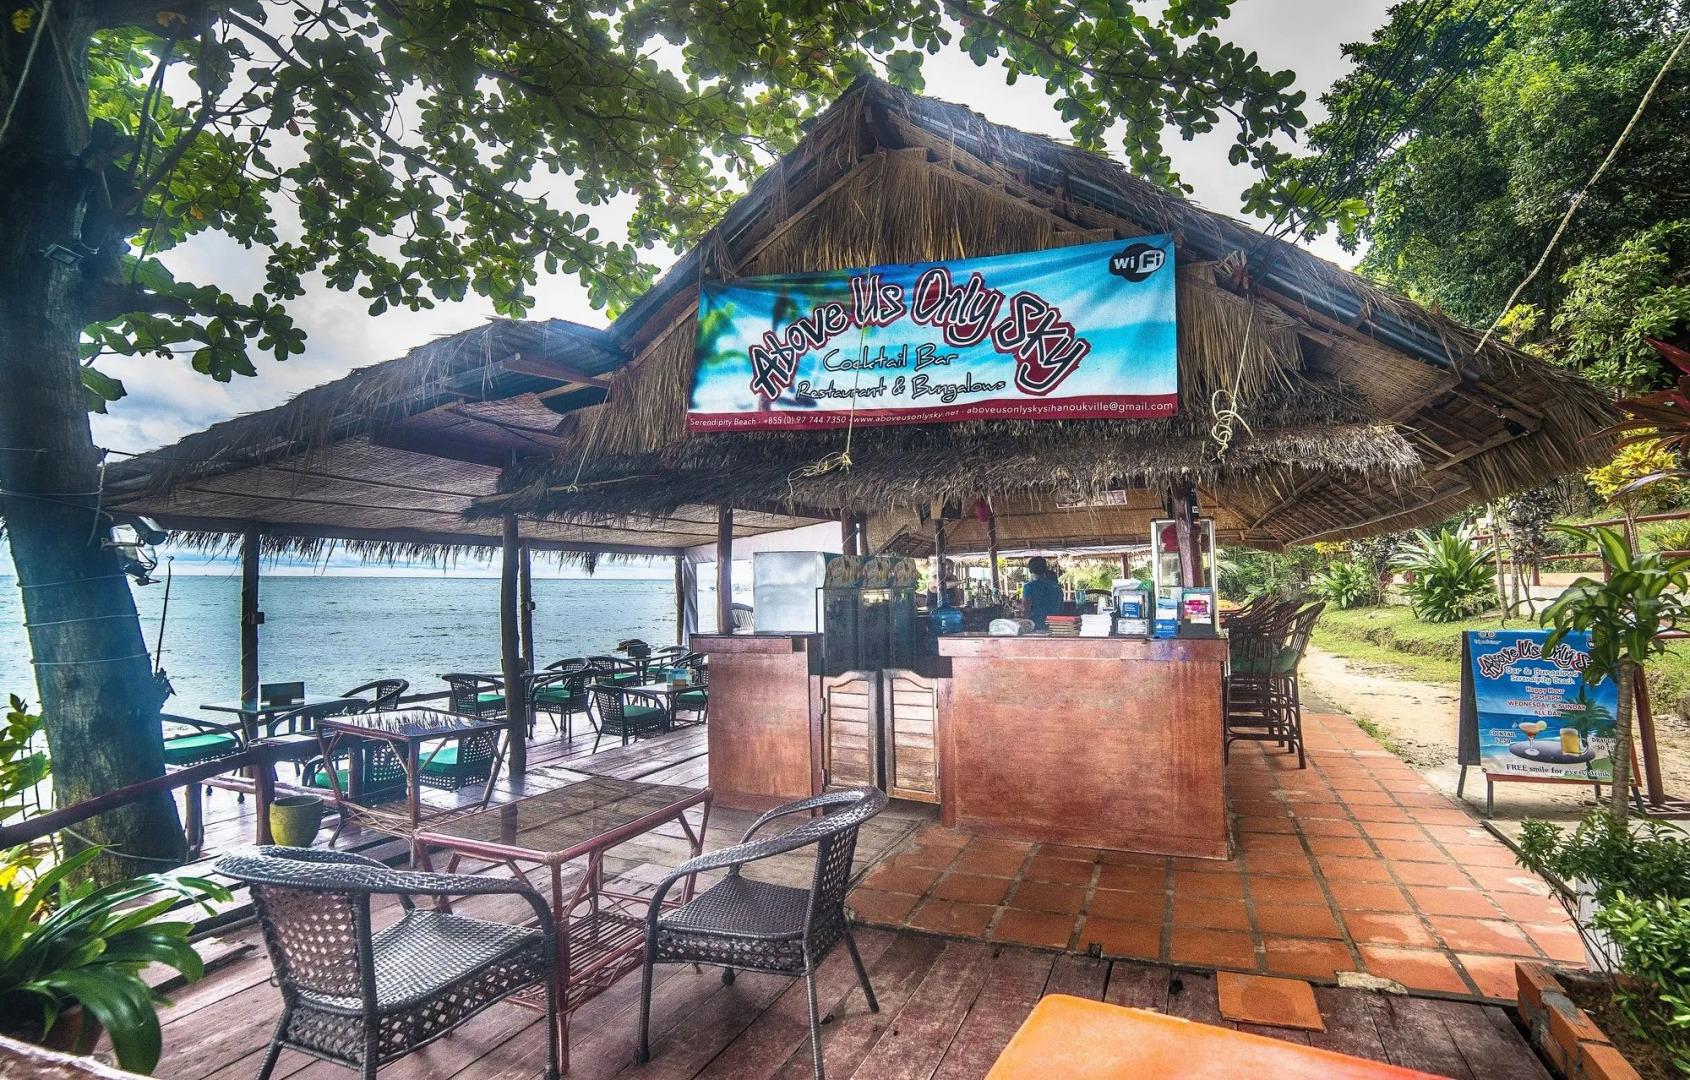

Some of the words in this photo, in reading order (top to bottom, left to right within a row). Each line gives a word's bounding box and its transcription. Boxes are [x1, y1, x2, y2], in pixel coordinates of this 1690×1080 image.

[751, 303, 849, 400] Above
[851, 274, 904, 326] Us
[913, 268, 1000, 346] Only
[995, 294, 1087, 393] Sky
[823, 343, 908, 372] Cocktail
[914, 343, 959, 371] Bar
[796, 377, 888, 399] Restaurant
[891, 376, 907, 396] &
[911, 373, 1007, 403] Bungalows
[690, 417, 732, 427] Serendipity
[734, 418, 757, 426] Beach
[763, 416, 782, 425] +855
[809, 415, 824, 424] 744
[826, 415, 847, 424] 7350
[853, 409, 960, 423] www.aboveusonlysky.net
[966, 401, 1174, 414] aboveusonlyskysihanoukville@gmail.com
[1480, 648, 1518, 678] Above
[1518, 640, 1541, 659] Us
[1505, 666, 1521, 674] Bar
[1534, 667, 1579, 677] Bungalows
[1510, 674, 1551, 685] Serendipity
[1525, 686, 1547, 695] Happy
[1508, 700, 1549, 708] WEDNESDAY
[1506, 763, 1528, 772] FREE
[1529, 766, 1549, 774] smile
[1551, 766, 1563, 774] for
